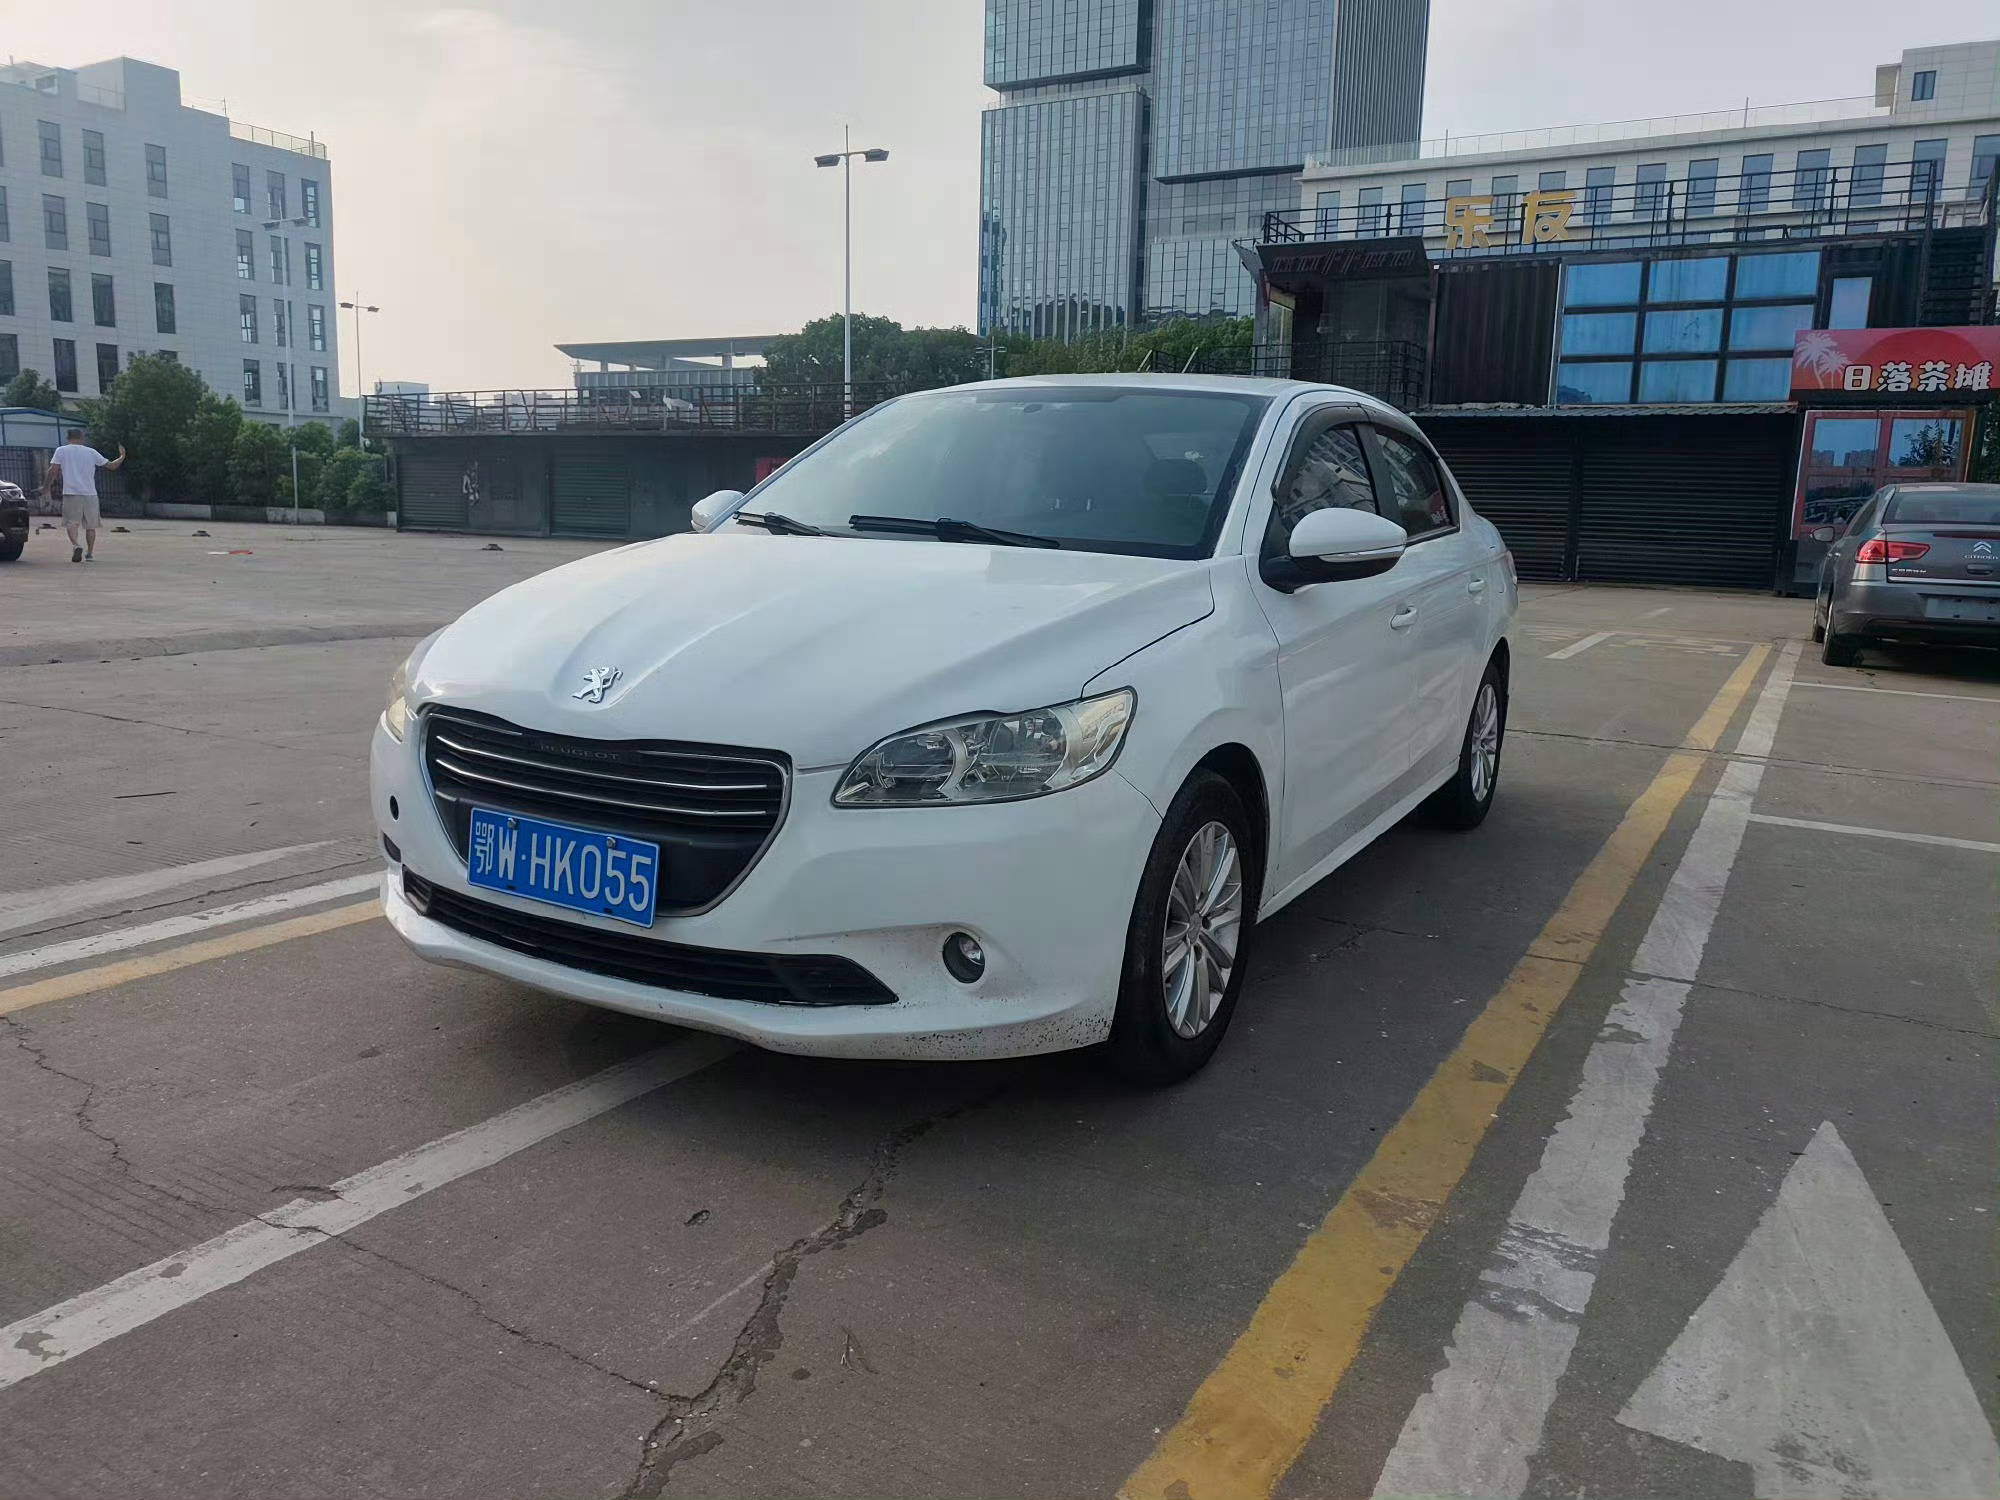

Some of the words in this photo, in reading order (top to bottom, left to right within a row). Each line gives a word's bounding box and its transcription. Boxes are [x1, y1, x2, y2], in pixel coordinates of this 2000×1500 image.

[1843, 360, 1993, 392] 日落茶摊
[541, 743, 620, 760] PEUGEOT
